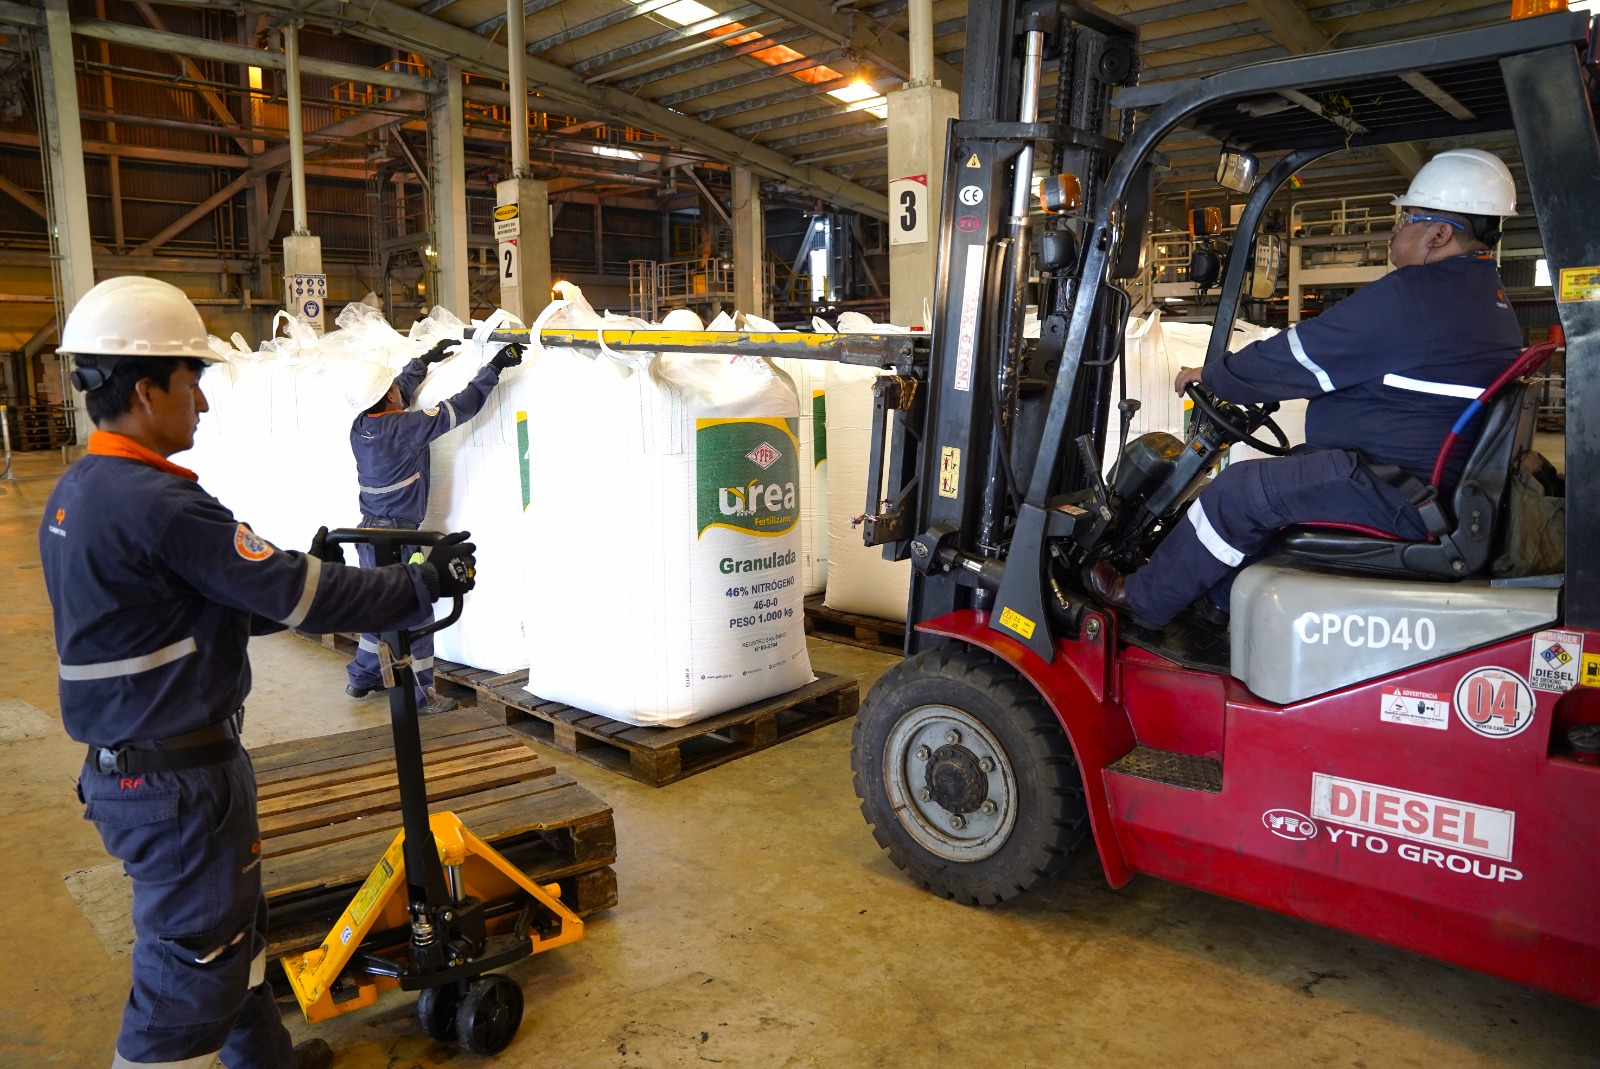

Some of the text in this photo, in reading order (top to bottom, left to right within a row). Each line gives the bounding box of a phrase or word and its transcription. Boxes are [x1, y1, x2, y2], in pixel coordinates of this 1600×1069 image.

[963, 189, 980, 202] CE
[900, 190, 917, 232] 3
[504, 249, 513, 278] 2
[718, 480, 796, 516] urea
[754, 514, 792, 526] Fertilizante
[719, 549, 796, 575] Granulada
[725, 576, 795, 598] 46% NITRÓGENO
[753, 597, 778, 610] 46-0-0
[729, 615, 756, 629] PESO
[758, 609, 782, 623] 1.000
[1299, 611, 1436, 651] CPCD40
[741, 637, 765, 648] REGISTRO
[1553, 645, 1560, 653] 2
[1545, 651, 1551, 659] 0
[1535, 668, 1574, 682] DIESEL
[1540, 677, 1562, 685] SMOKING
[1402, 690, 1438, 700] ADVERTENCIA
[1467, 676, 1520, 728] 04
[120, 778, 144, 790] RF
[1329, 783, 1489, 850] DIESEL
[1325, 825, 1524, 883] YTO GROUP
